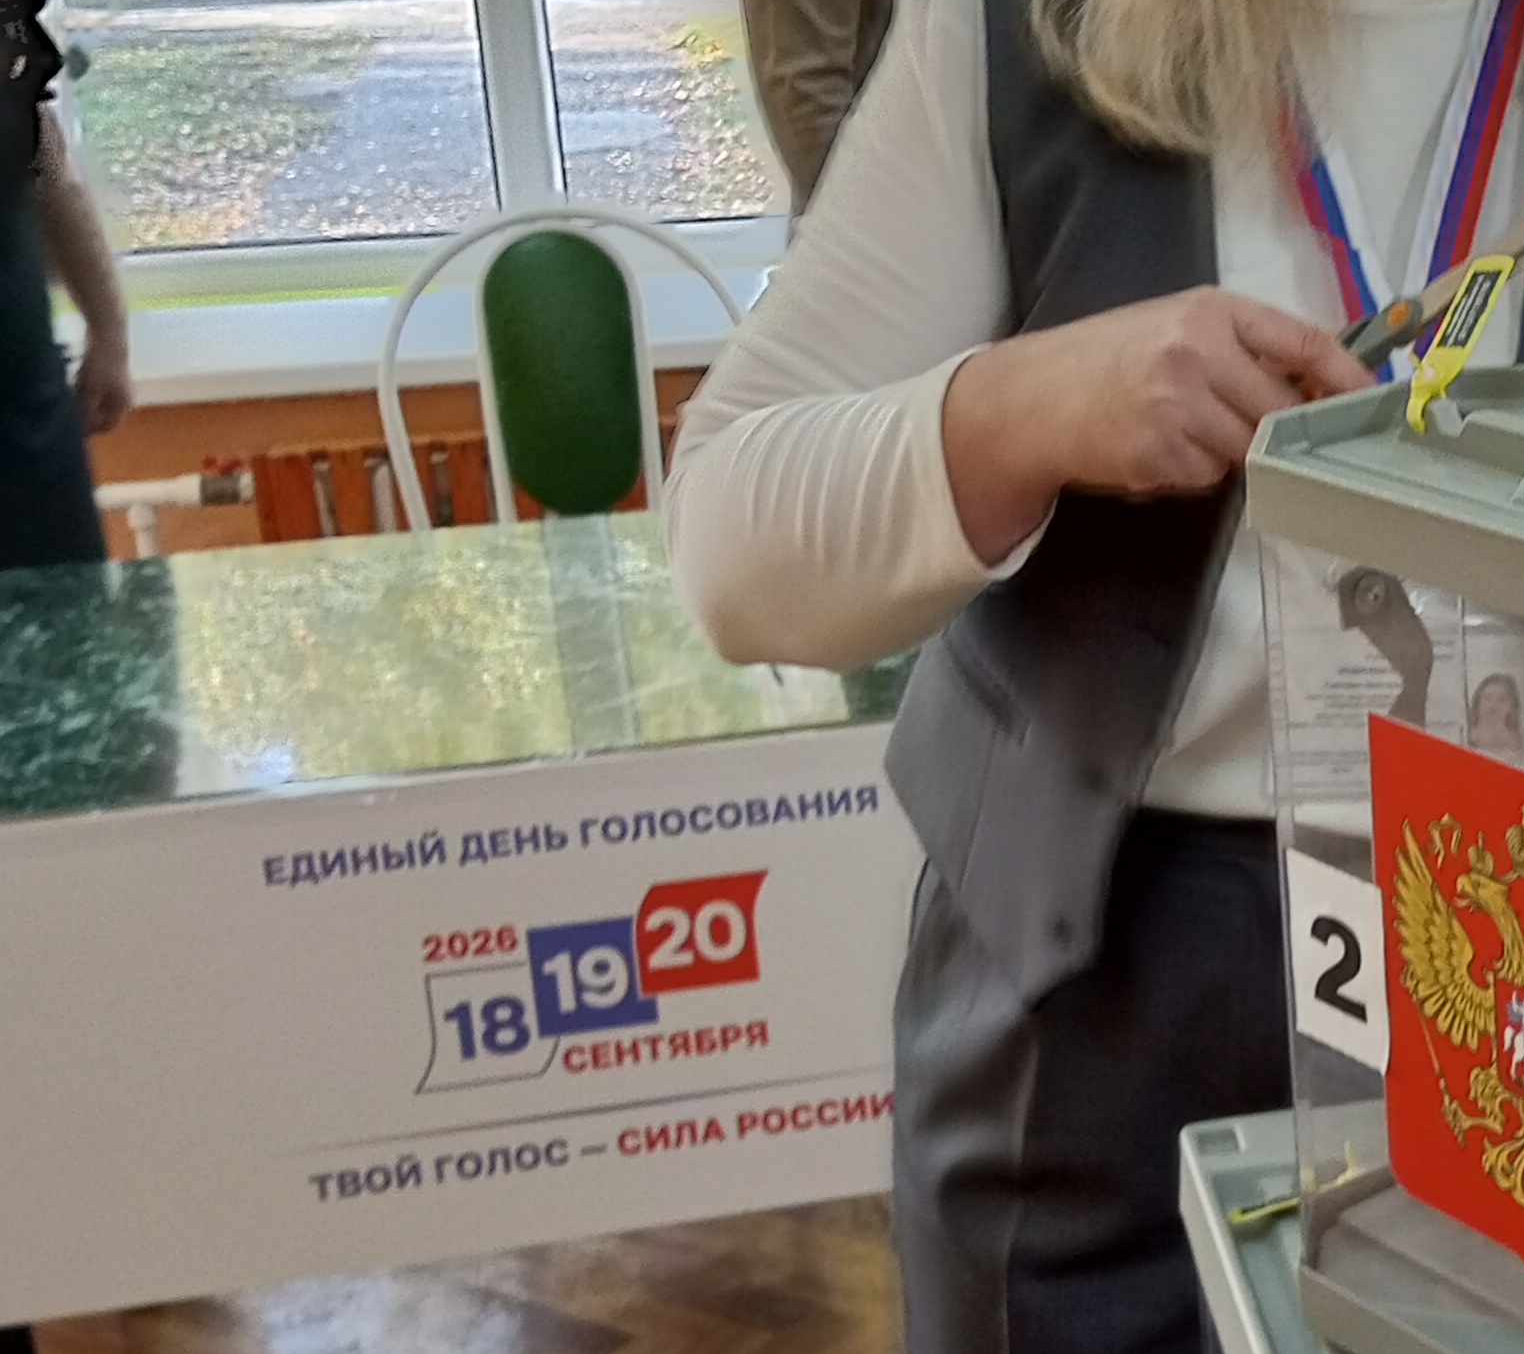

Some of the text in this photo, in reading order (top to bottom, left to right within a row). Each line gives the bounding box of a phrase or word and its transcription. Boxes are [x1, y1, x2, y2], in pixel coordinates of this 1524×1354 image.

[264, 784, 879, 887] ЕДИНЫЙ ДЕНЬ ГОЛОСОВАНИЯ
[423, 924, 519, 963] 2026
[444, 899, 748, 1062] 18 19 20
[1310, 914, 1368, 1024] 2
[562, 1020, 771, 1075] СЕНТЯБРЯ
[309, 1153, 423, 1202] ТВОЙ
[435, 1138, 570, 1184] ГОЛОС
[618, 1116, 727, 1158] СИЛА
